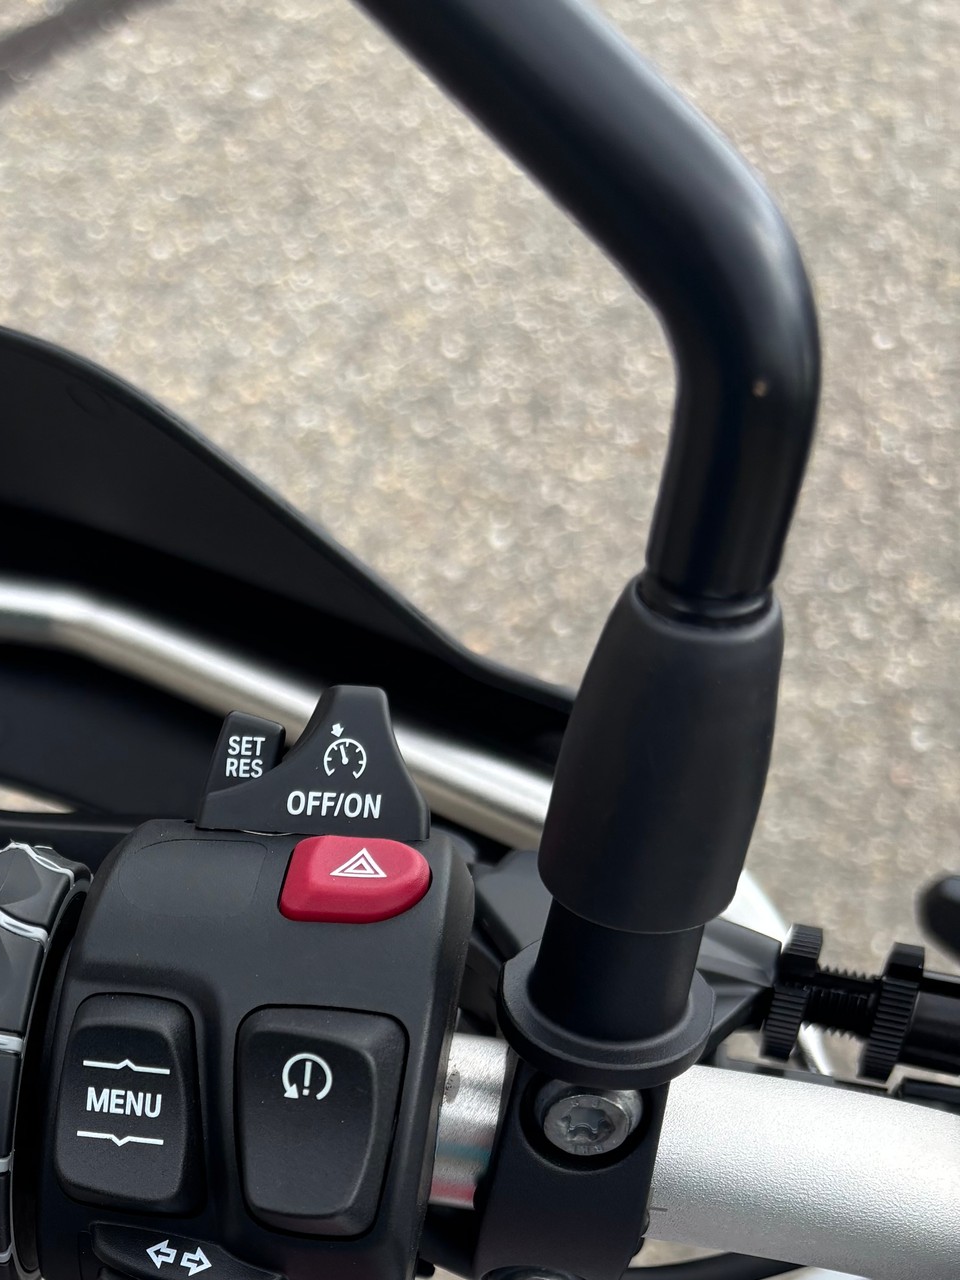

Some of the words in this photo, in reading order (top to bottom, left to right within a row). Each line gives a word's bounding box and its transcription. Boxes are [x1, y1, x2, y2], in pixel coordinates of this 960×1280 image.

[227, 735, 266, 757] SET
[225, 757, 264, 779] RES
[286, 790, 382, 819] OFF/ON
[86, 1086, 163, 1118] MENU
